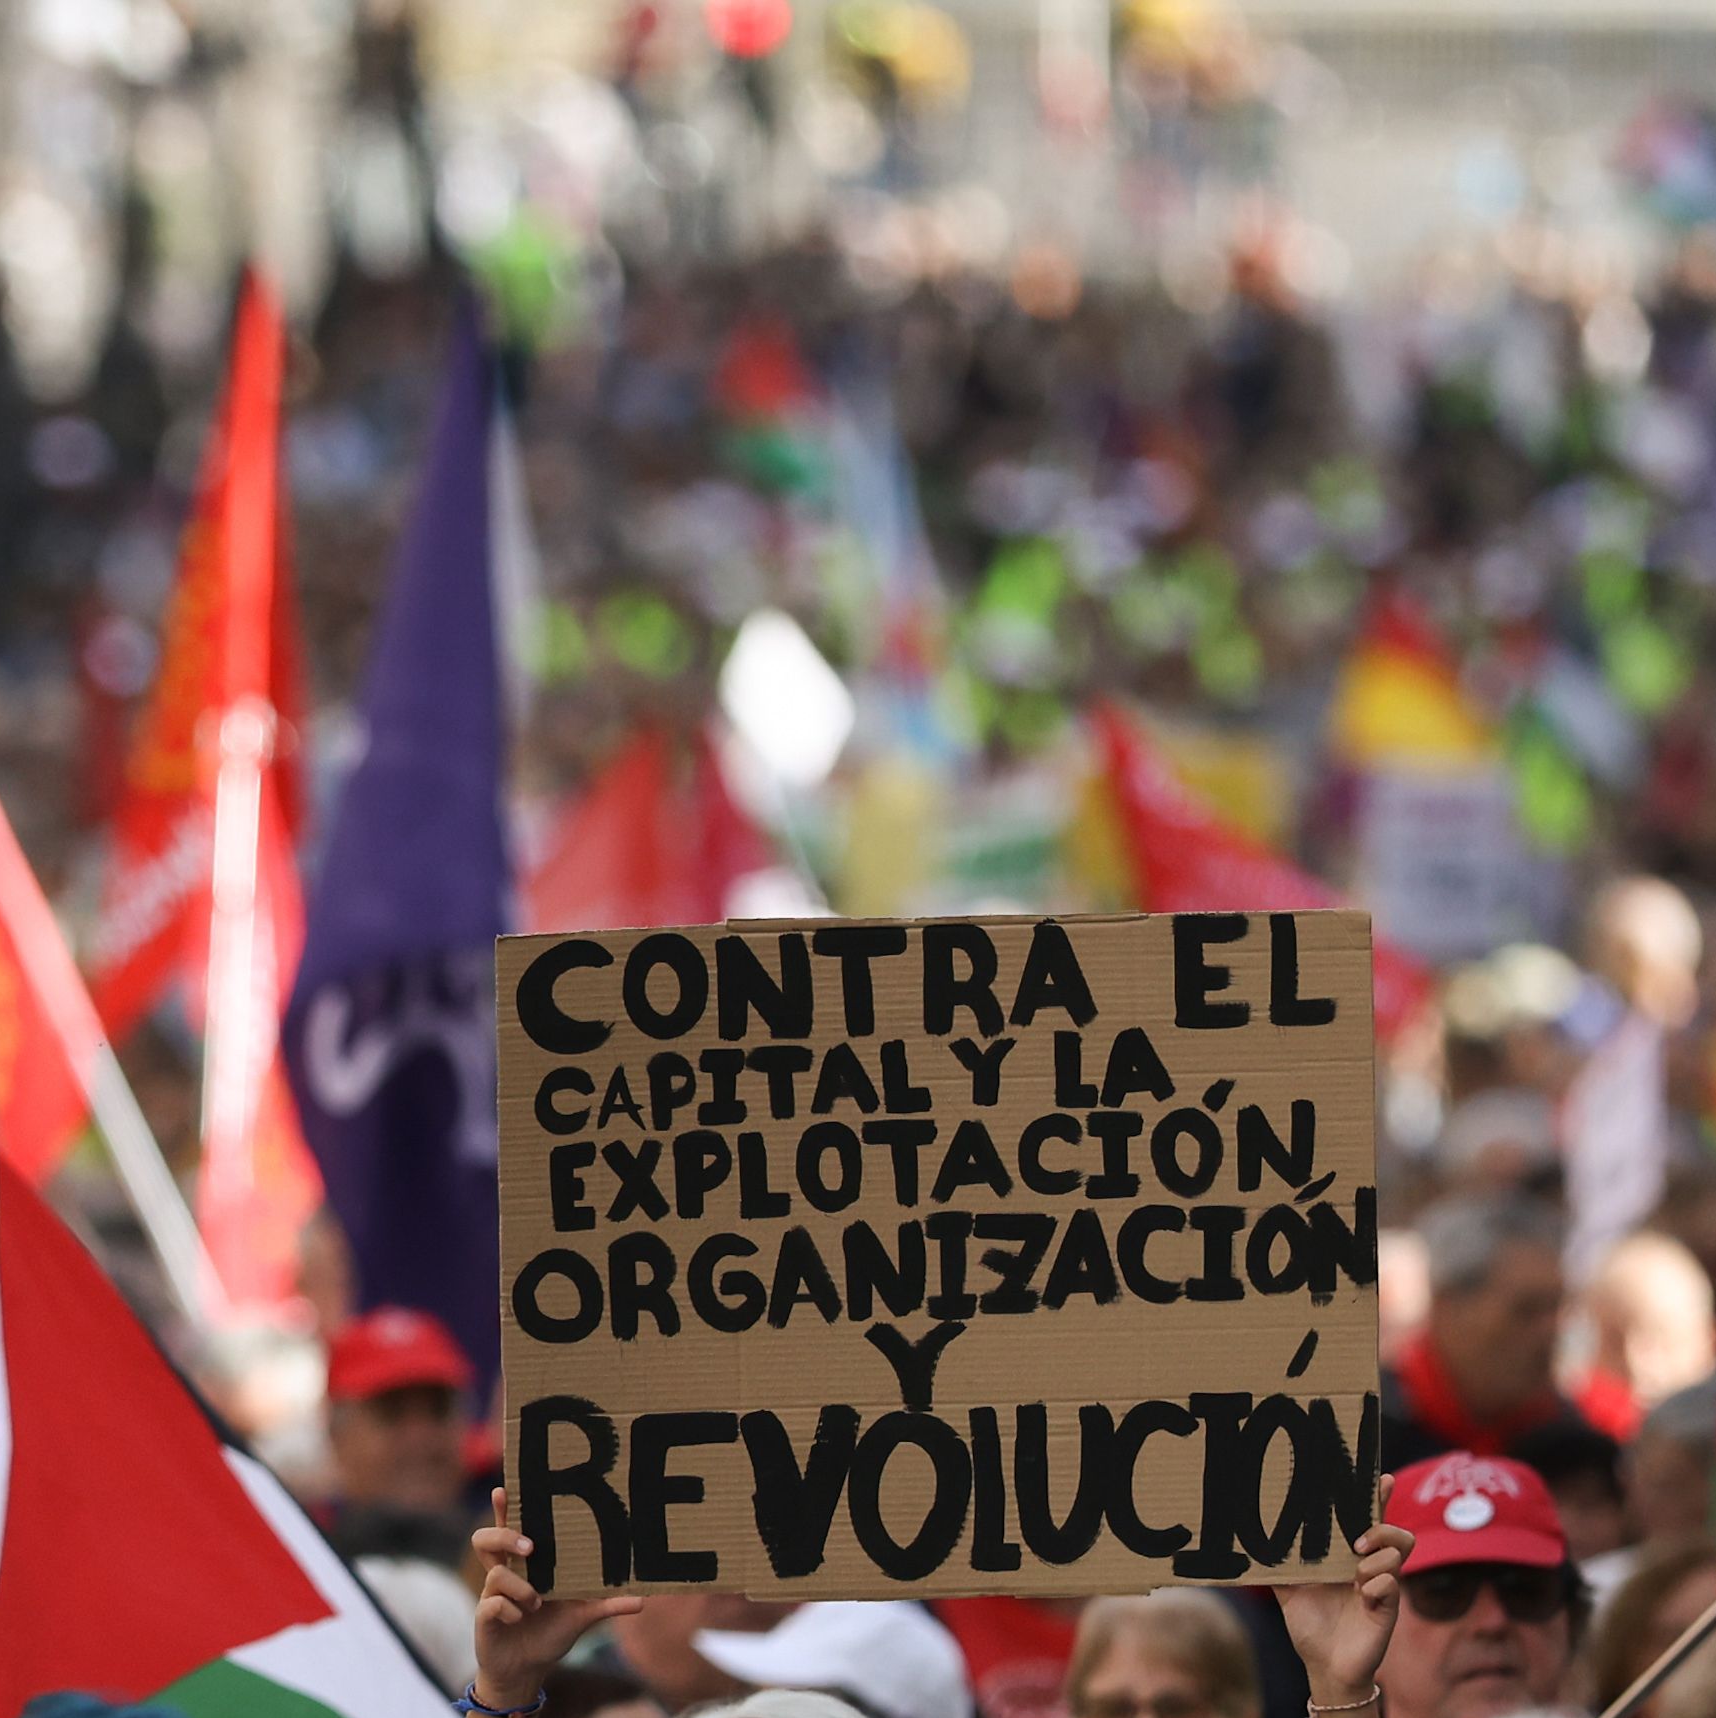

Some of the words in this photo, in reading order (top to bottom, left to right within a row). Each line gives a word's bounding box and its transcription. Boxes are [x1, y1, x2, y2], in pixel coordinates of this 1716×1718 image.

[515, 919, 1100, 1057] CONTRA
[1171, 913, 1339, 1030] EL
[533, 1038, 935, 1137] CAPITAL
[946, 1036, 1019, 1108] Y
[1052, 1026, 1176, 1110] LA
[548, 1078, 1317, 1234] EXPLOTACIÓN
[510, 1170, 1379, 1345] ORGANIZACIÓN
[863, 1320, 968, 1413] Y
[517, 1328, 1381, 1594] REVOLUCIÓN
